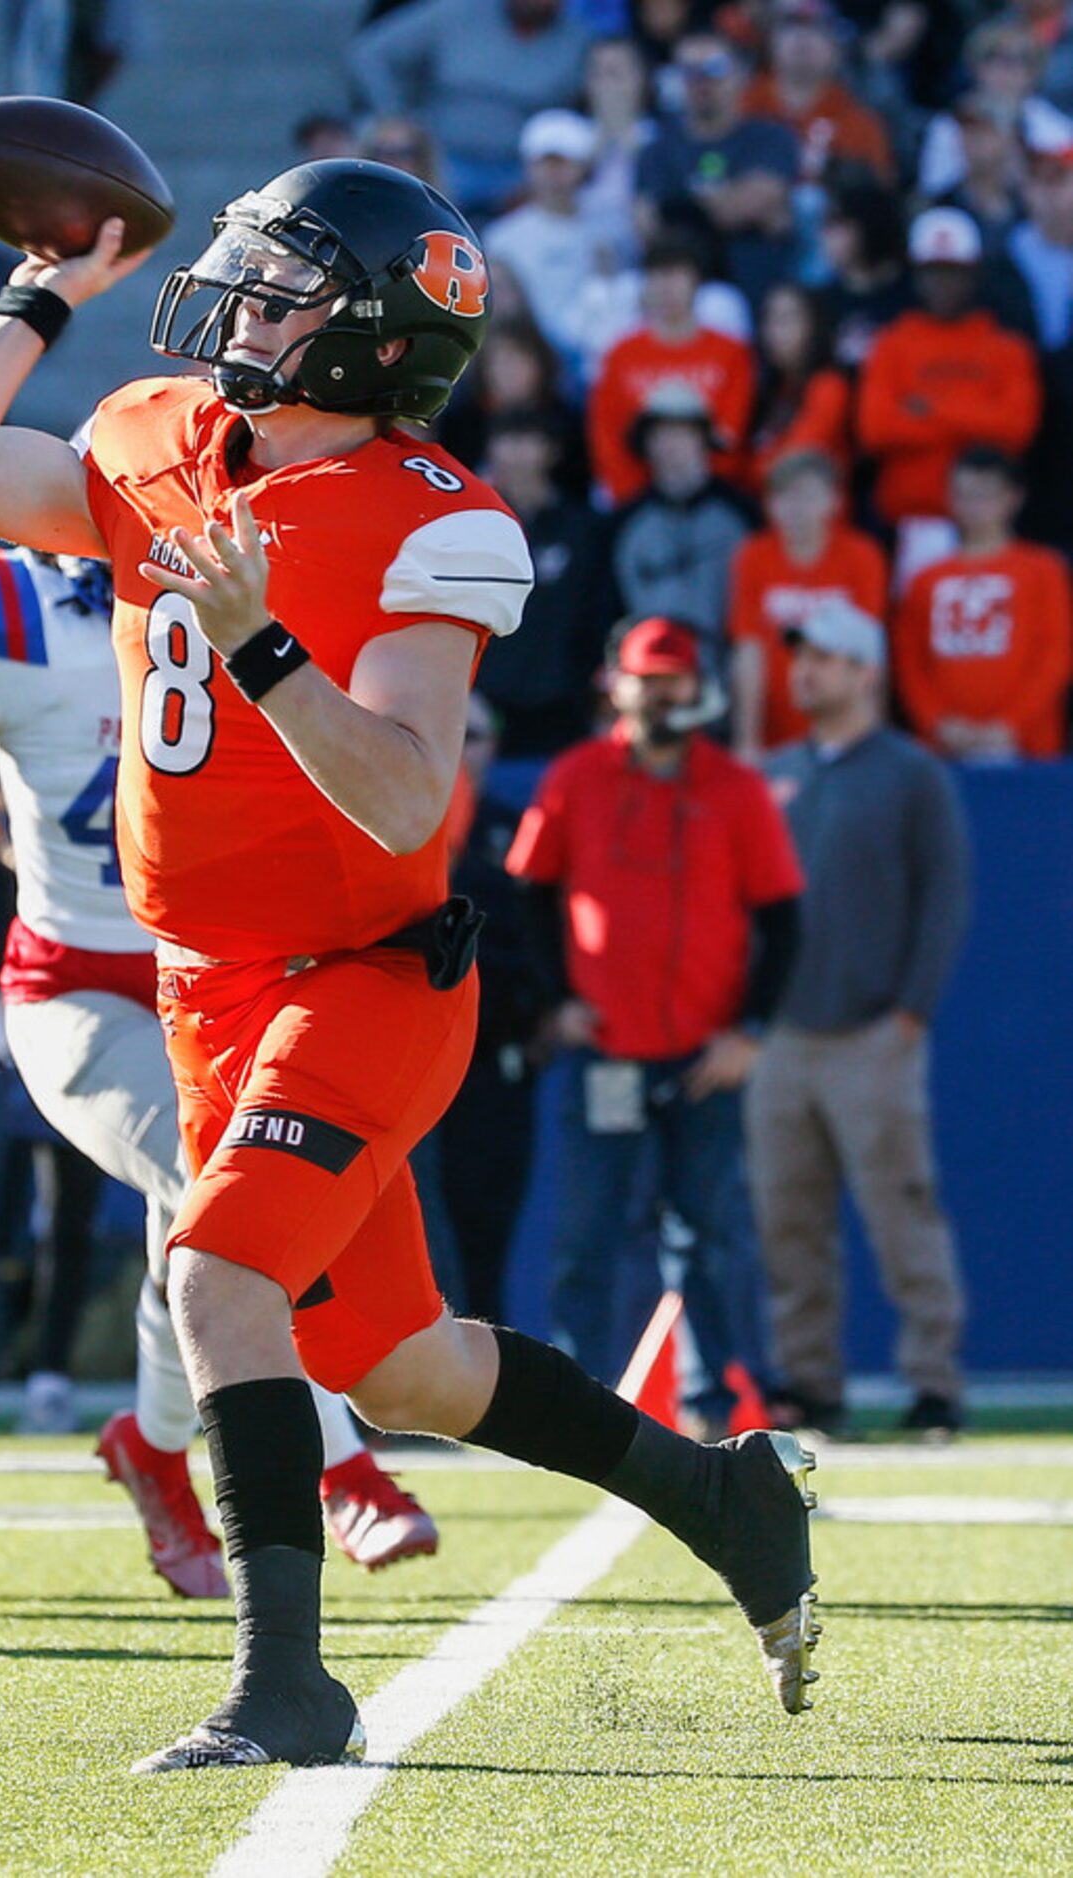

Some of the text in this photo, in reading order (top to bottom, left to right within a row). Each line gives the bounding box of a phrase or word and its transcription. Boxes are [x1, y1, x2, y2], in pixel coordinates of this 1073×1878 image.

[411, 229, 489, 318] R
[401, 456, 465, 493] 8
[148, 534, 206, 581] ROCK
[140, 588, 215, 777] 8
[59, 755, 123, 887] 4
